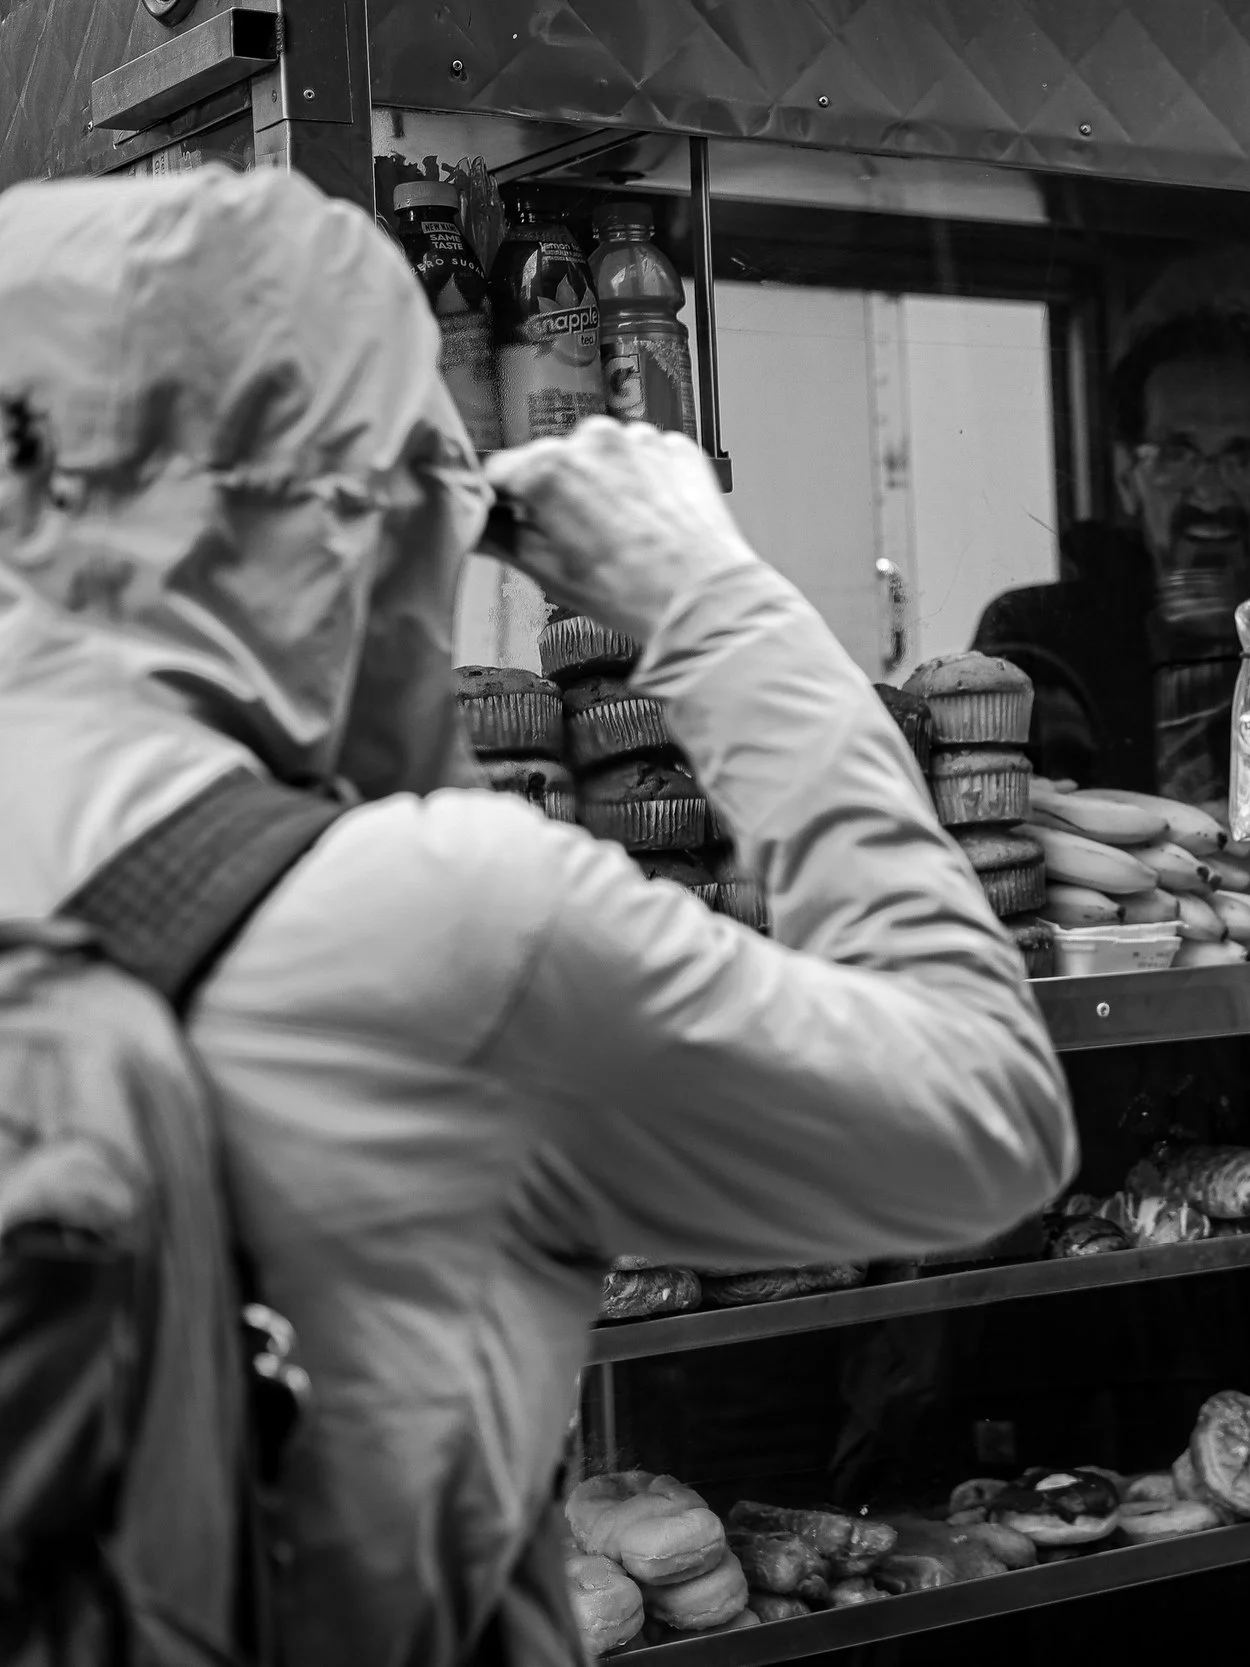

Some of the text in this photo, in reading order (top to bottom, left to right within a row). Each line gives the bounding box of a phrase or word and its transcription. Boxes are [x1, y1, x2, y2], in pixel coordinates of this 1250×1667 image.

[430, 233, 461, 243] SAME
[432, 241, 464, 250] TASTE
[410, 258, 444, 277] ZERO
[530, 304, 599, 334] napple
[581, 335, 594, 345] tea
